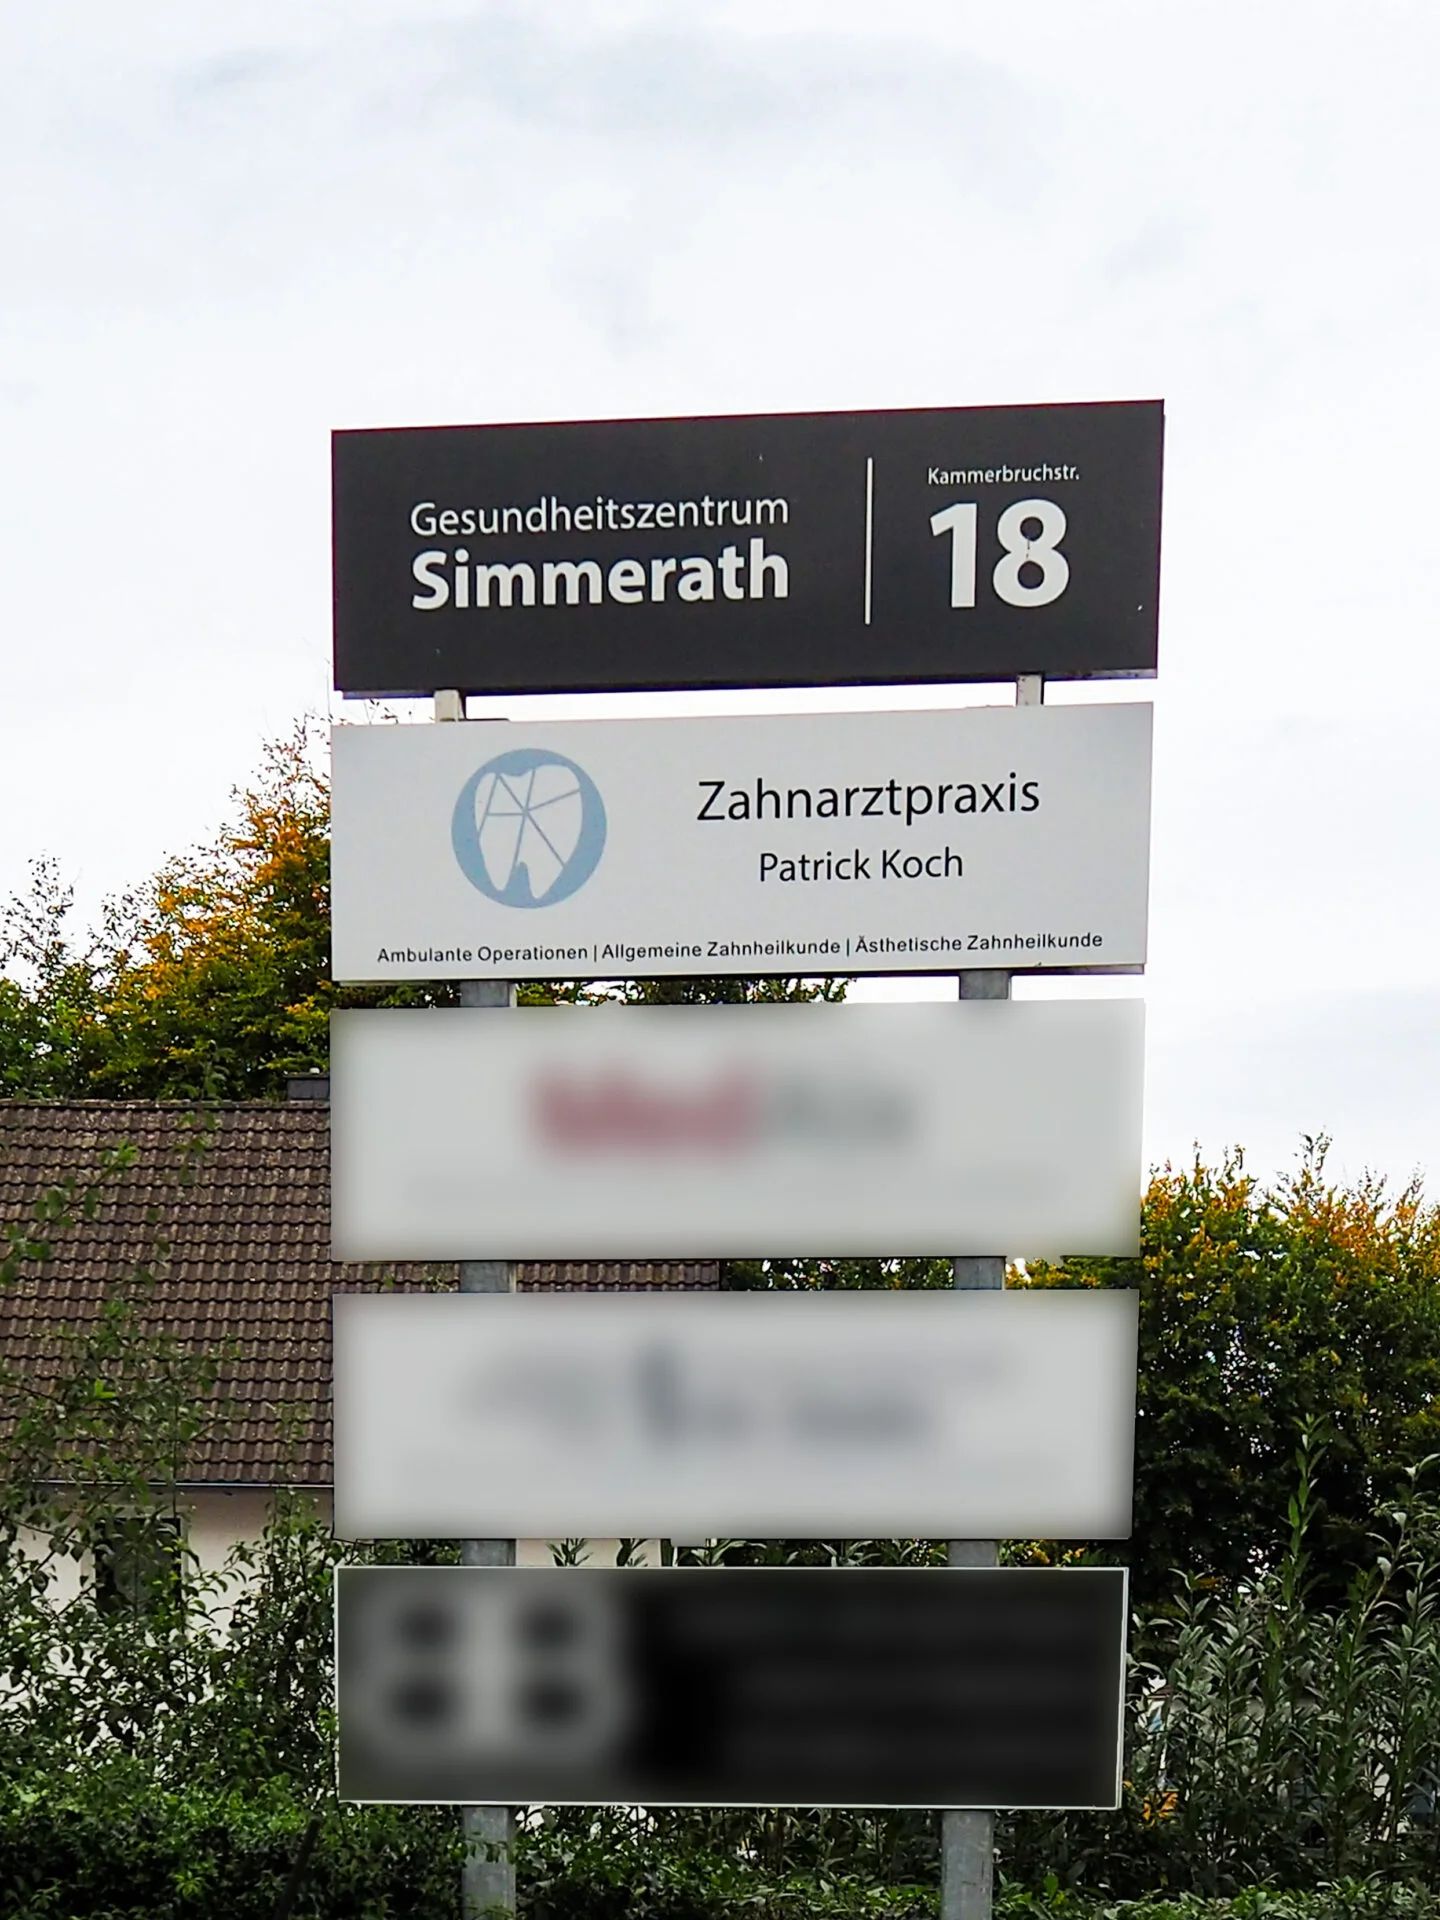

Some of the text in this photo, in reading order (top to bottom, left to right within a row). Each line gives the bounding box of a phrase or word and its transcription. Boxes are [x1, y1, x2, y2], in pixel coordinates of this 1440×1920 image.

[928, 463, 1080, 485] Kammerbruchstr.
[410, 495, 788, 536] Gesundheitszentrum
[412, 537, 788, 610] Simmerath
[930, 499, 1070, 608] 18
[696, 771, 1040, 827] Zahnarztpraxis
[760, 845, 963, 883] Patrick Koch
[377, 931, 1103, 965] Ambulante Operationen Allgemeine Zahnheilkunde Ästhetische Zahnheilkunde
